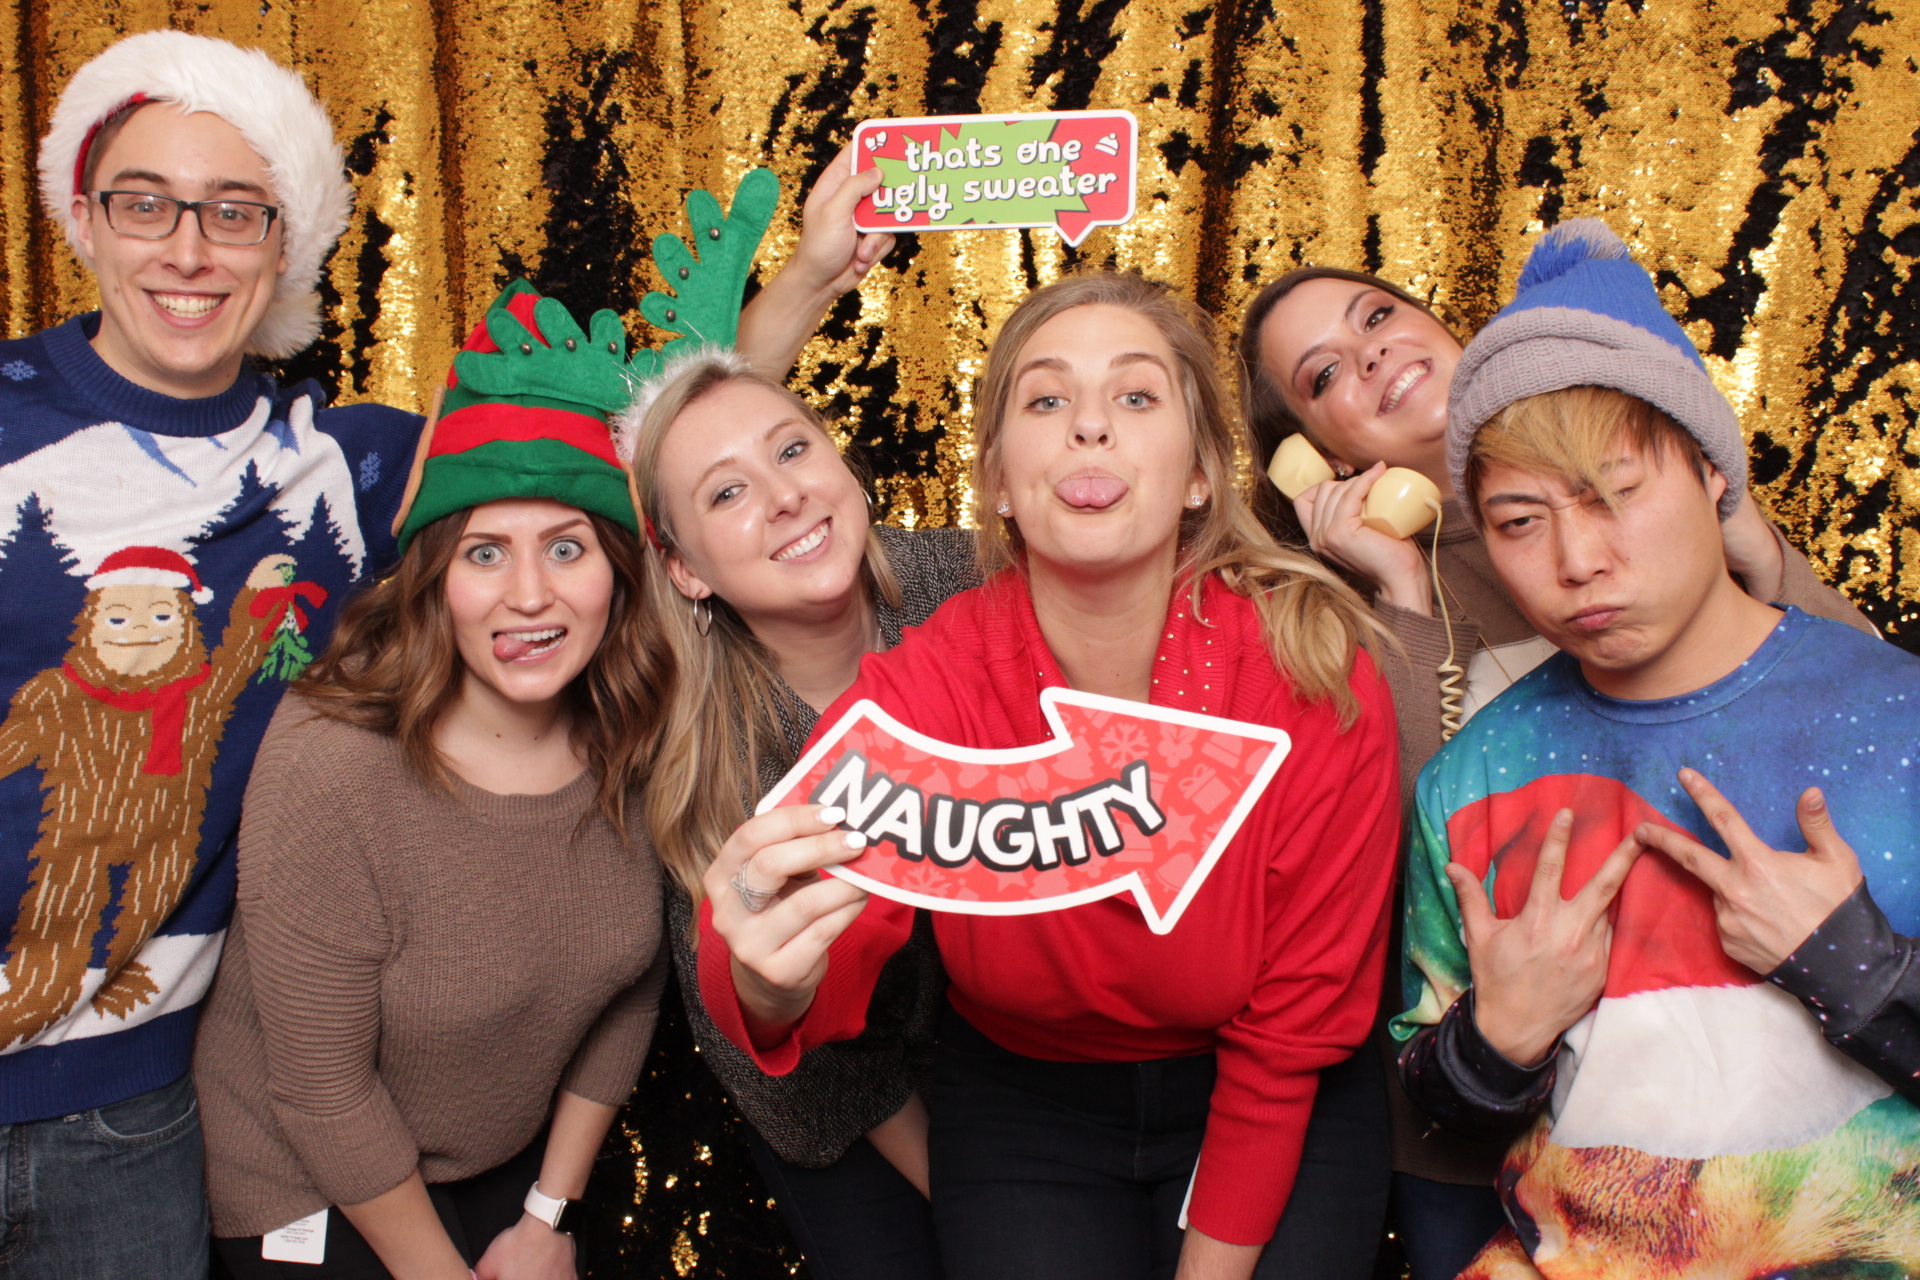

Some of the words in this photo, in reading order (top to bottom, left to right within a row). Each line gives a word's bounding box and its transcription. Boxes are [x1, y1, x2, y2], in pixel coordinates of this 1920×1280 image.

[905, 137, 1001, 172] thats
[1016, 139, 1082, 165] one
[872, 174, 953, 222] ugly
[963, 165, 1117, 203] sweater
[815, 752, 1165, 868] NAUGHTY
